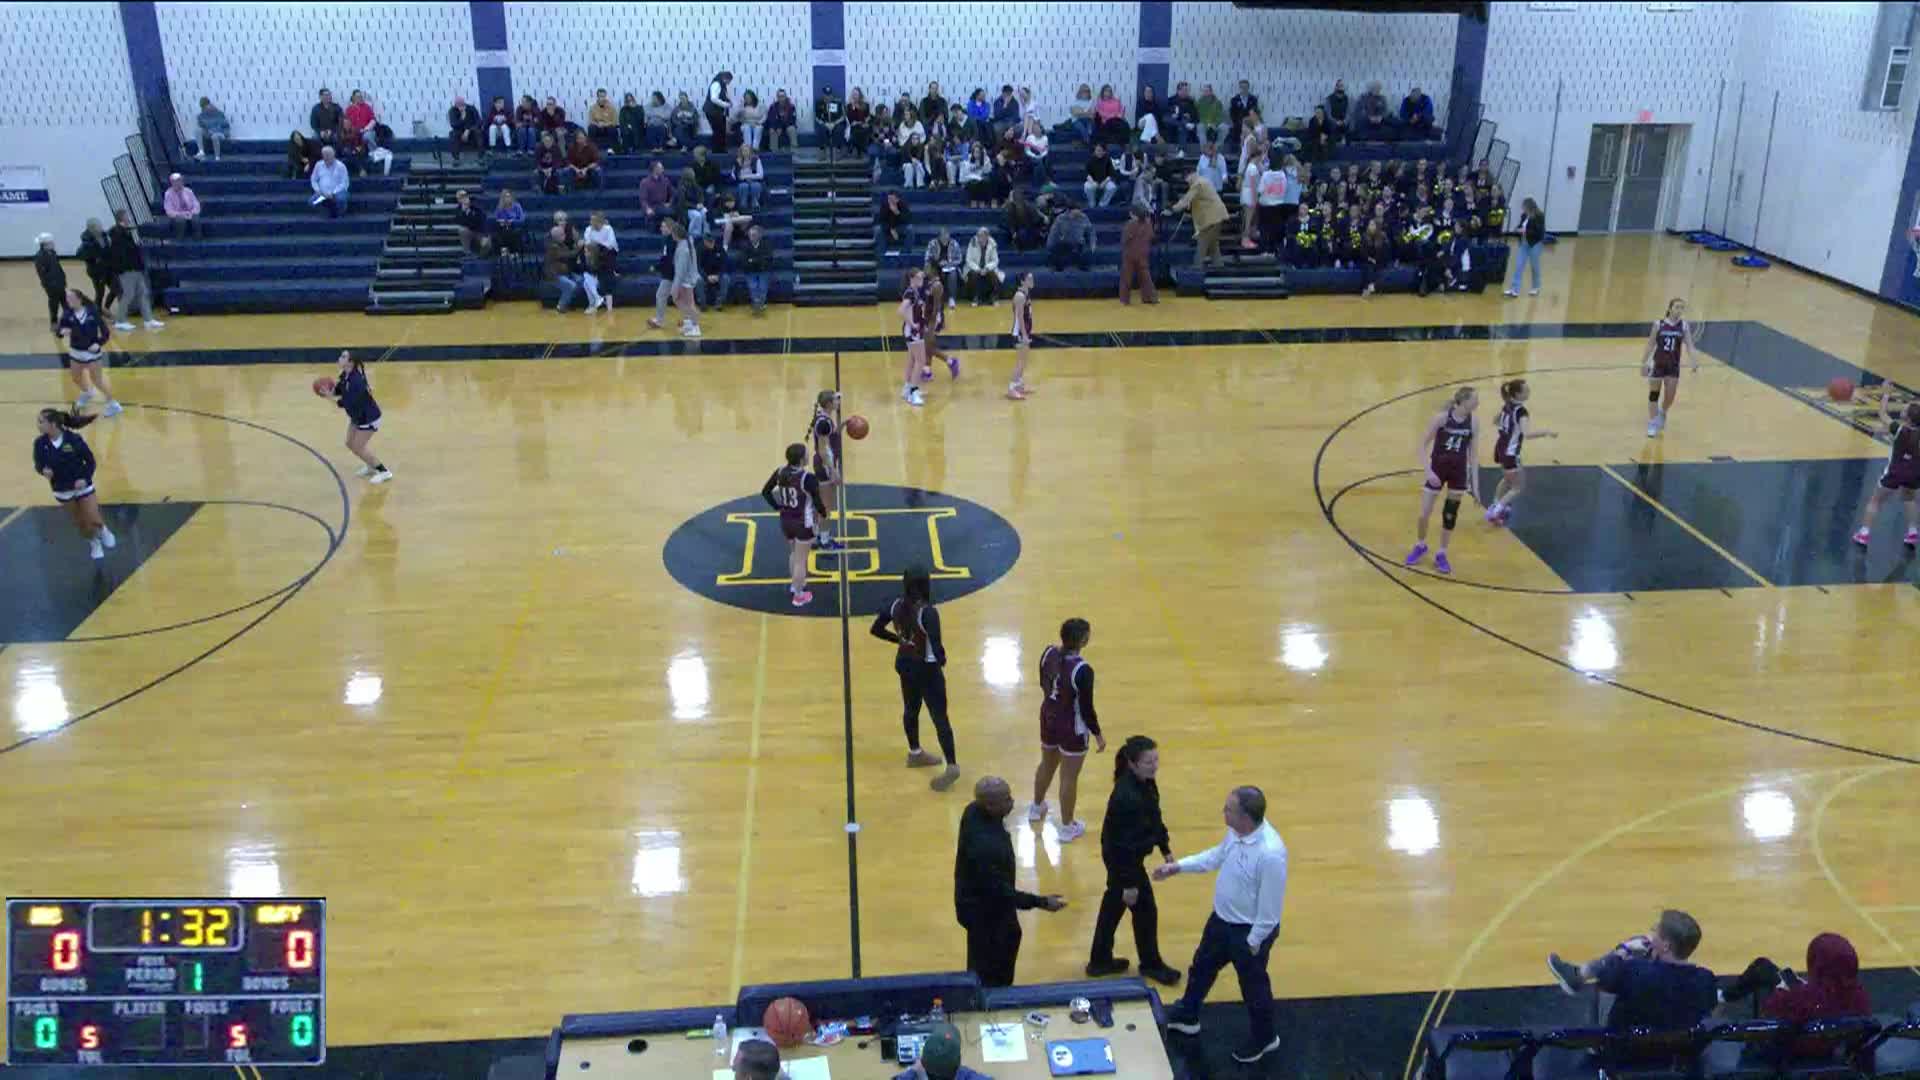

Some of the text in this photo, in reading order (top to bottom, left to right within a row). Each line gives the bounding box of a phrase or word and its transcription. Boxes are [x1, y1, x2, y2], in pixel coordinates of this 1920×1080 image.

[0, 191, 29, 201] AME
[1663, 336, 1676, 352] 21
[782, 487, 799, 509] 13
